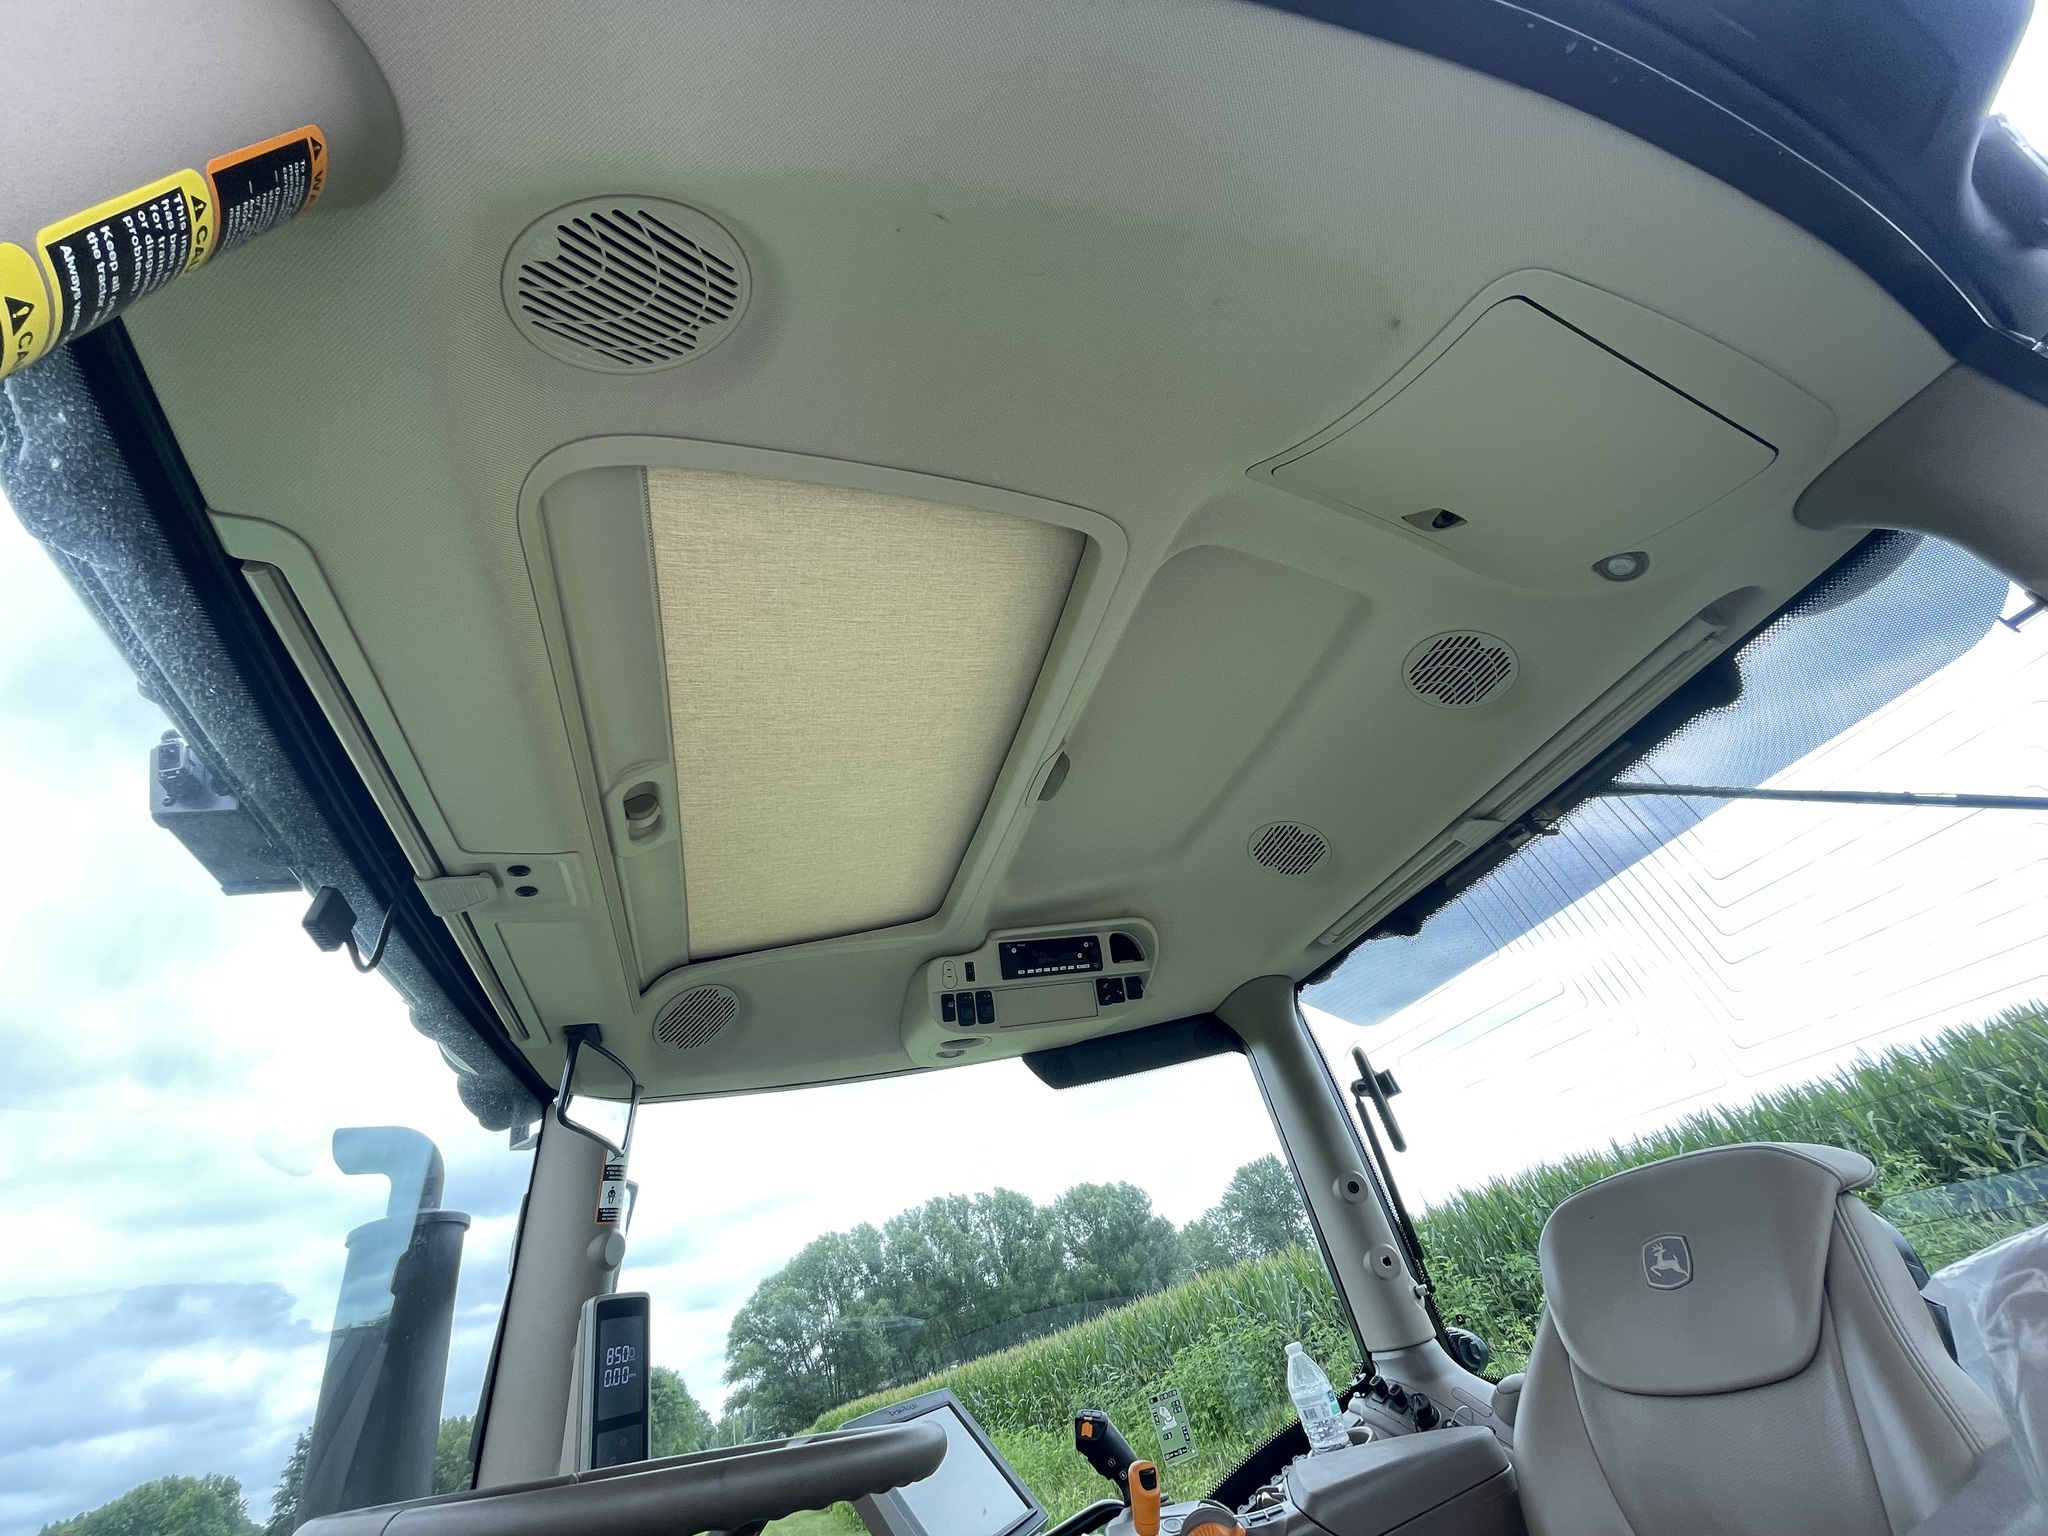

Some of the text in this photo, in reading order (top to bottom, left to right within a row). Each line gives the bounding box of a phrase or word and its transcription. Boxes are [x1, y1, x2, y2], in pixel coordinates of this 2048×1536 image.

[137, 210, 149, 229] or
[149, 203, 163, 230] for
[173, 193, 187, 230] This
[161, 198, 178, 269] has been
[59, 245, 82, 301] Always
[86, 231, 107, 307] the tractor
[100, 225, 120, 292] Keep all
[606, 1345, 630, 1366] 850
[603, 1366, 630, 1388] 0.00
